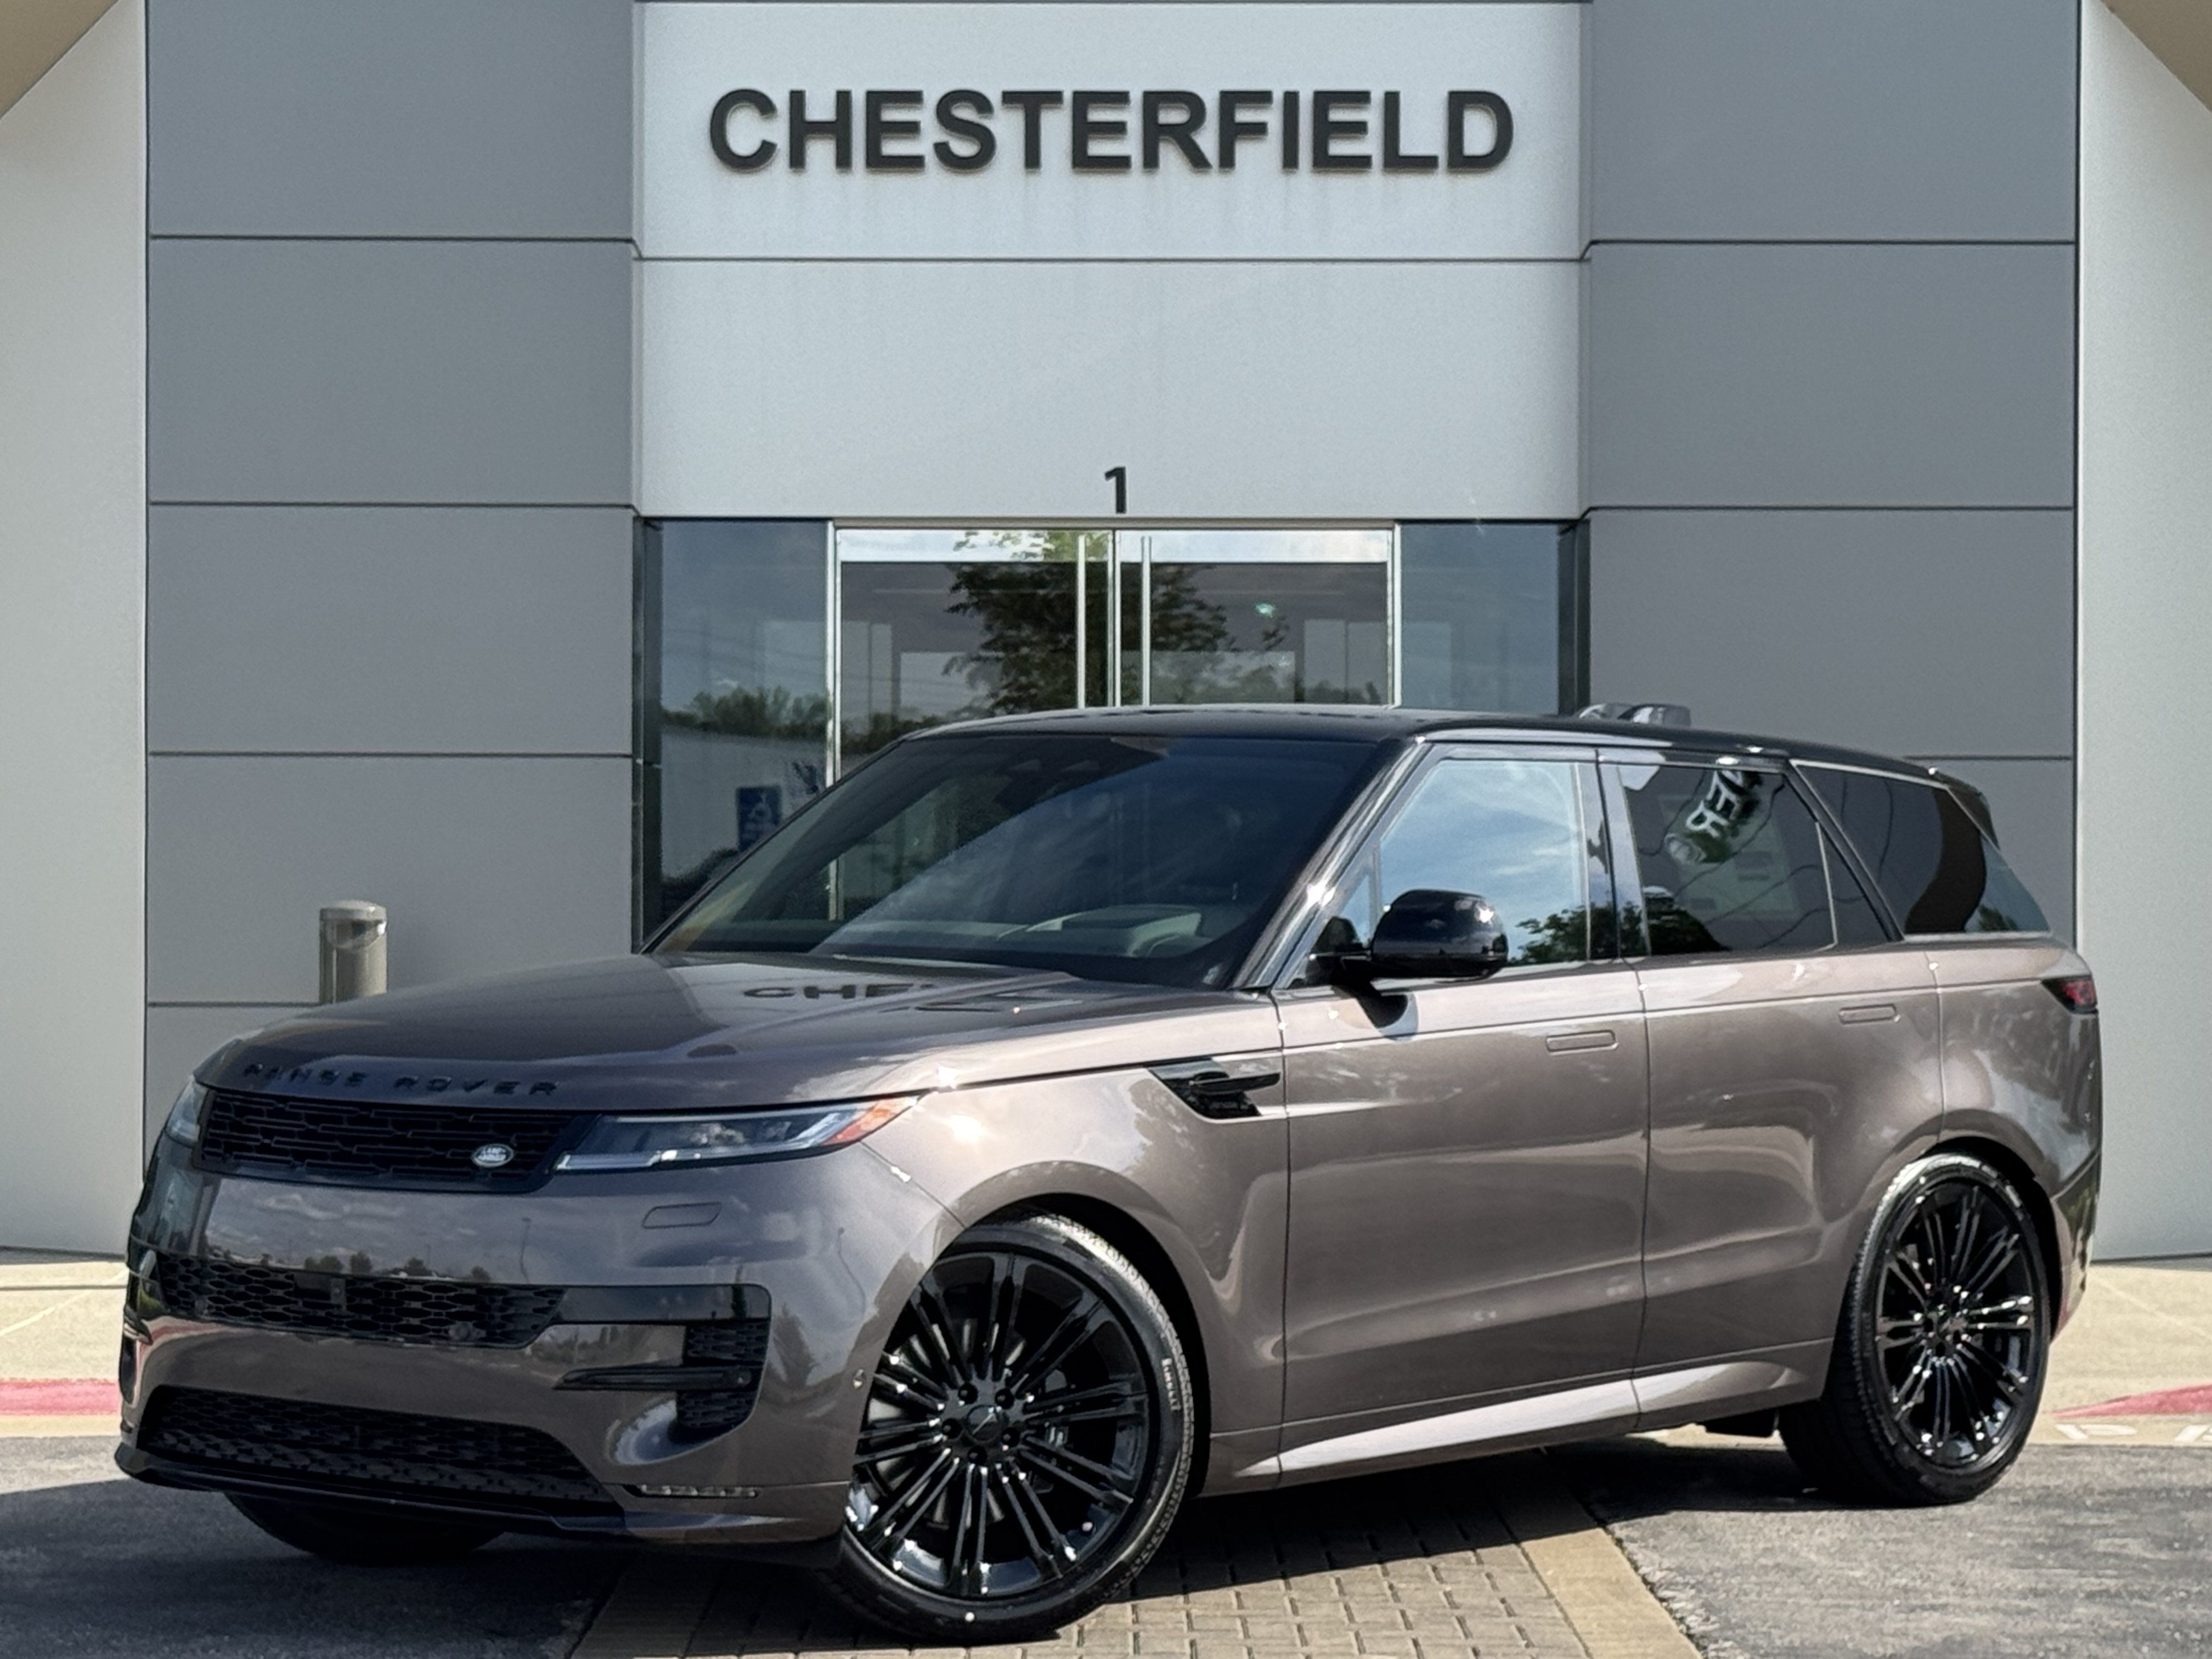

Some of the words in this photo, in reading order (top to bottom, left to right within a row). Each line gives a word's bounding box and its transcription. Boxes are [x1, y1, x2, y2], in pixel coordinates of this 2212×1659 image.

[710, 89, 1513, 174] CHESTERFIELD
[1105, 467, 1126, 514] 1
[393, 1076, 560, 1096] ROVER
